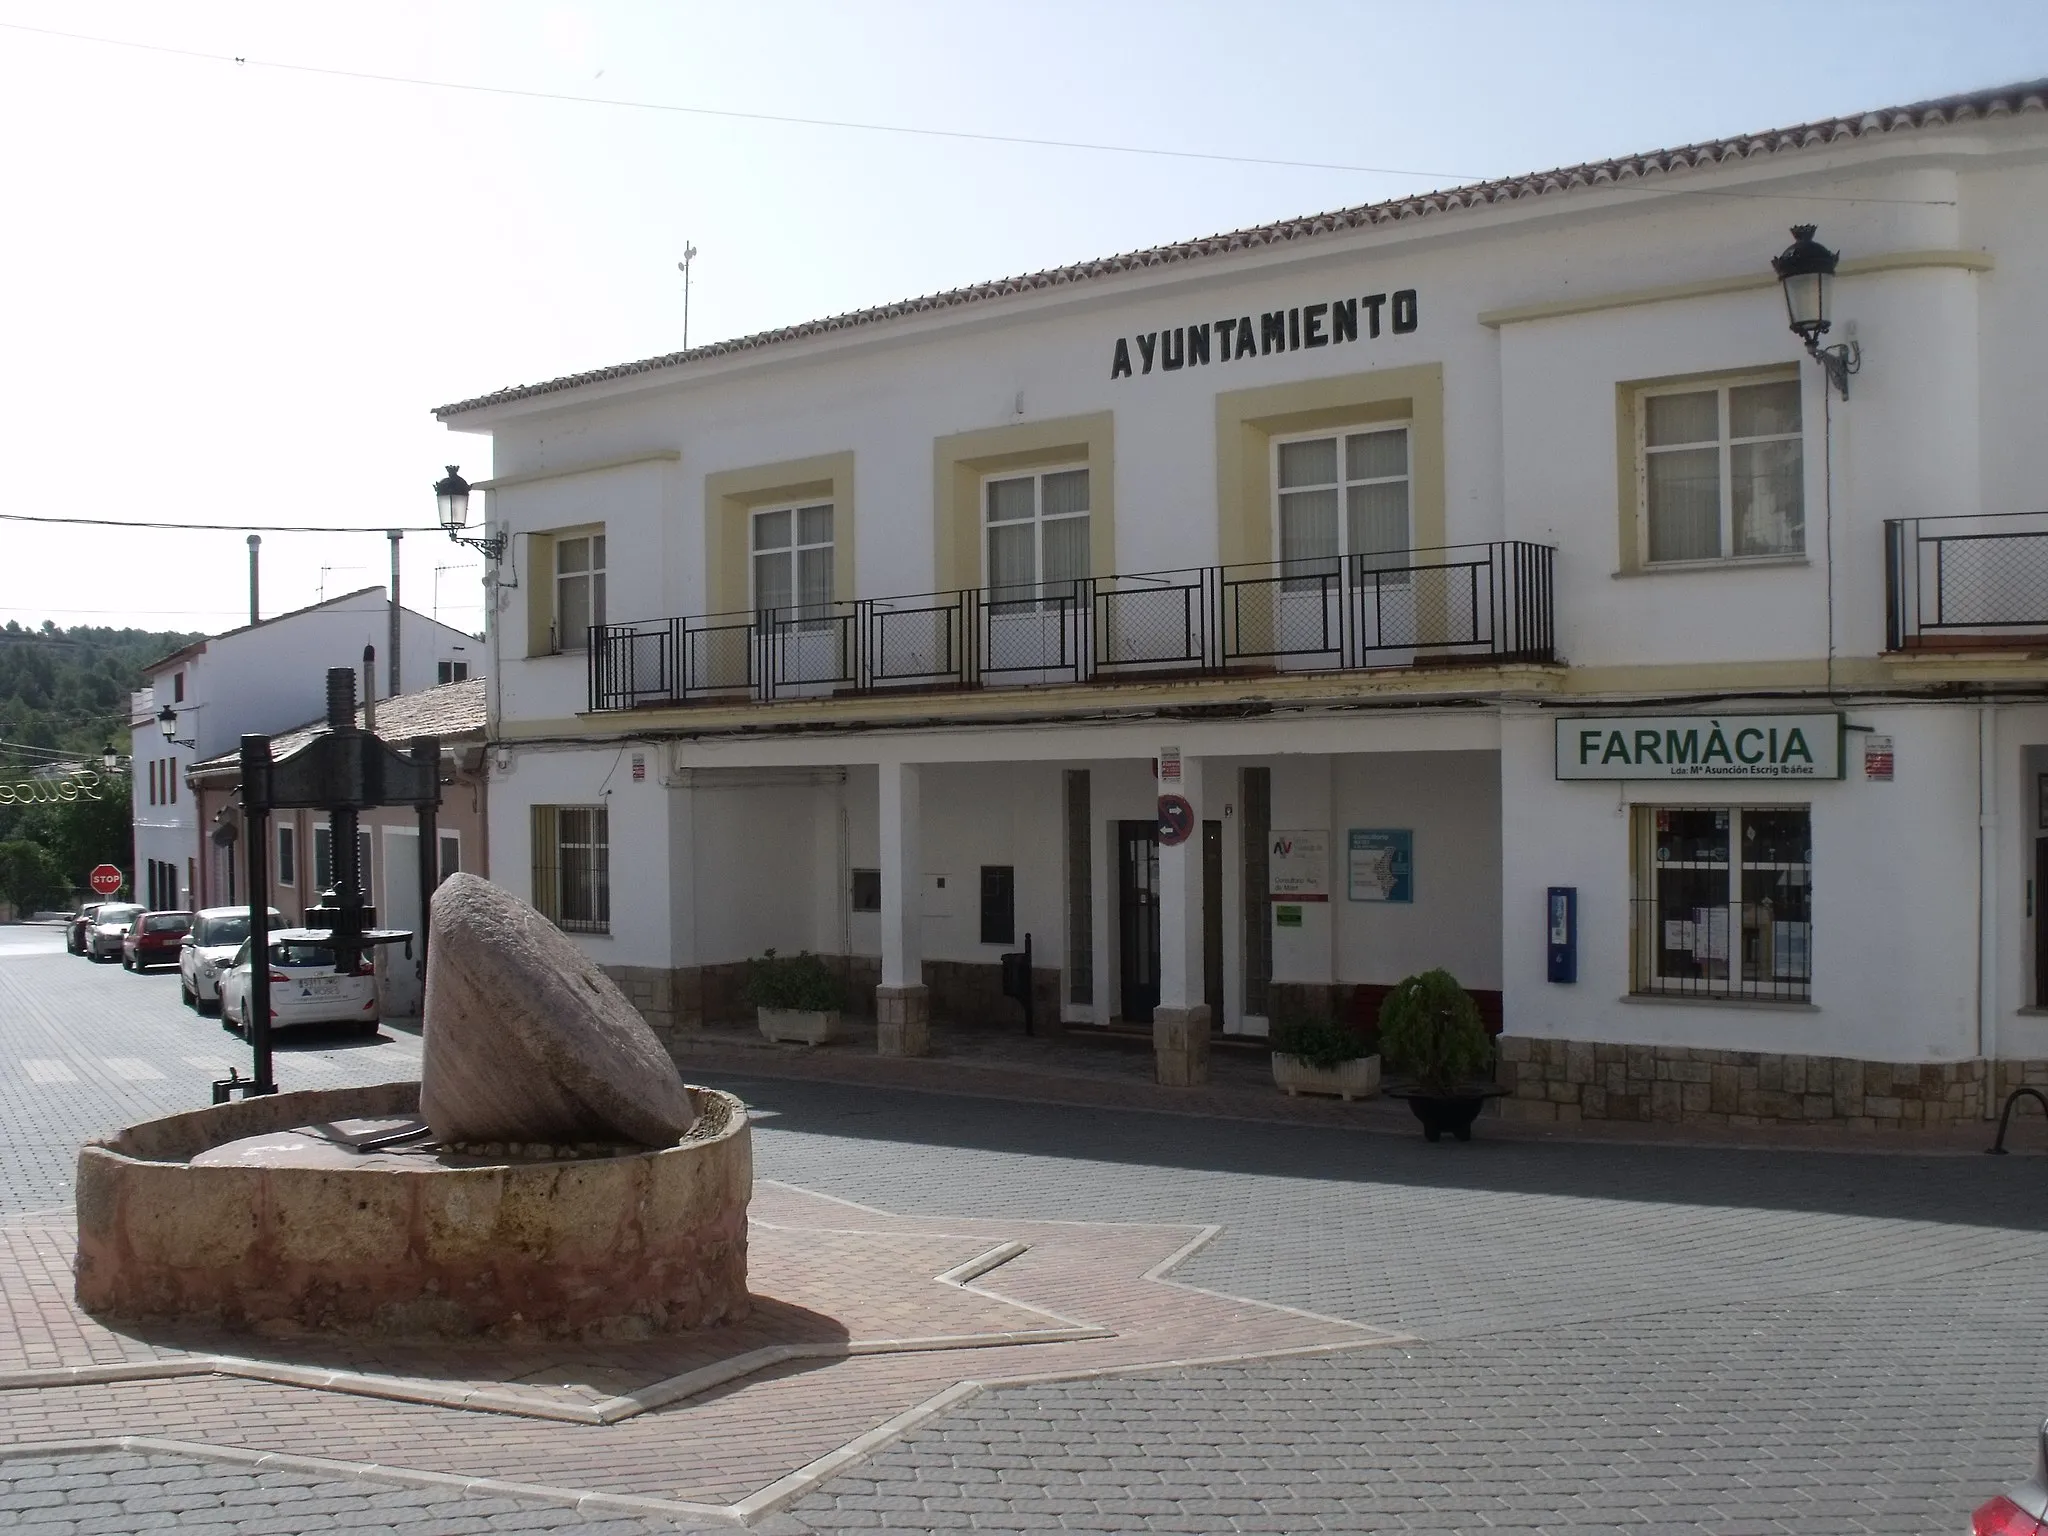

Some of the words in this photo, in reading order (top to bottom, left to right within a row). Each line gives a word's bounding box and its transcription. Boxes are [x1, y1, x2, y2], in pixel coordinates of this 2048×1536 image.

[1110, 288, 1419, 380] AYUNTAMIENTO
[1579, 719, 1814, 765] FARMÀCIA
[1705, 765, 1748, 775] Asunción
[1750, 765, 1779, 776] Escrig
[1780, 765, 1813, 774] Ibáñez
[93, 875, 120, 883] STOP
